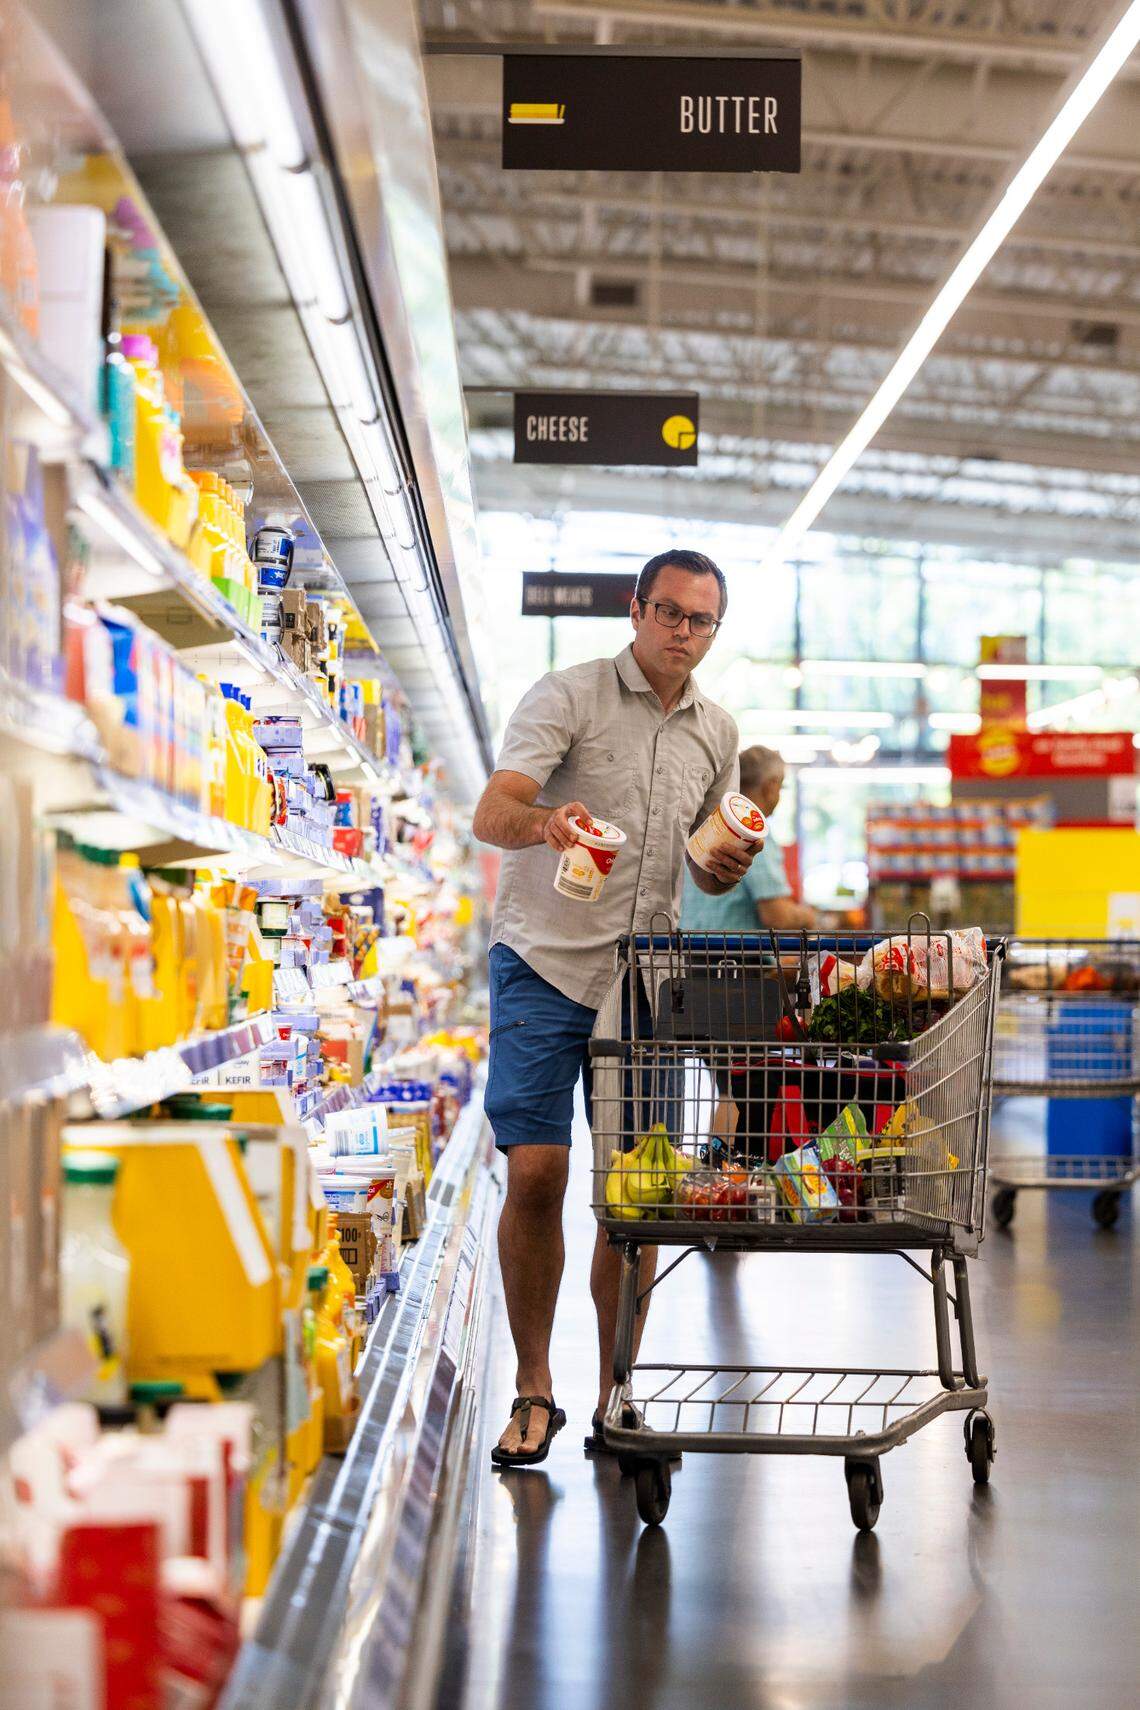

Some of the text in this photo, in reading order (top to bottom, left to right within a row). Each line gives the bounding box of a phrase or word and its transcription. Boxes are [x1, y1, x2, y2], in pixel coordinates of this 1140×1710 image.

[680, 95, 778, 134] BUTTER
[527, 415, 589, 442] CHEESE
[225, 1075, 251, 1085] KEFIR
